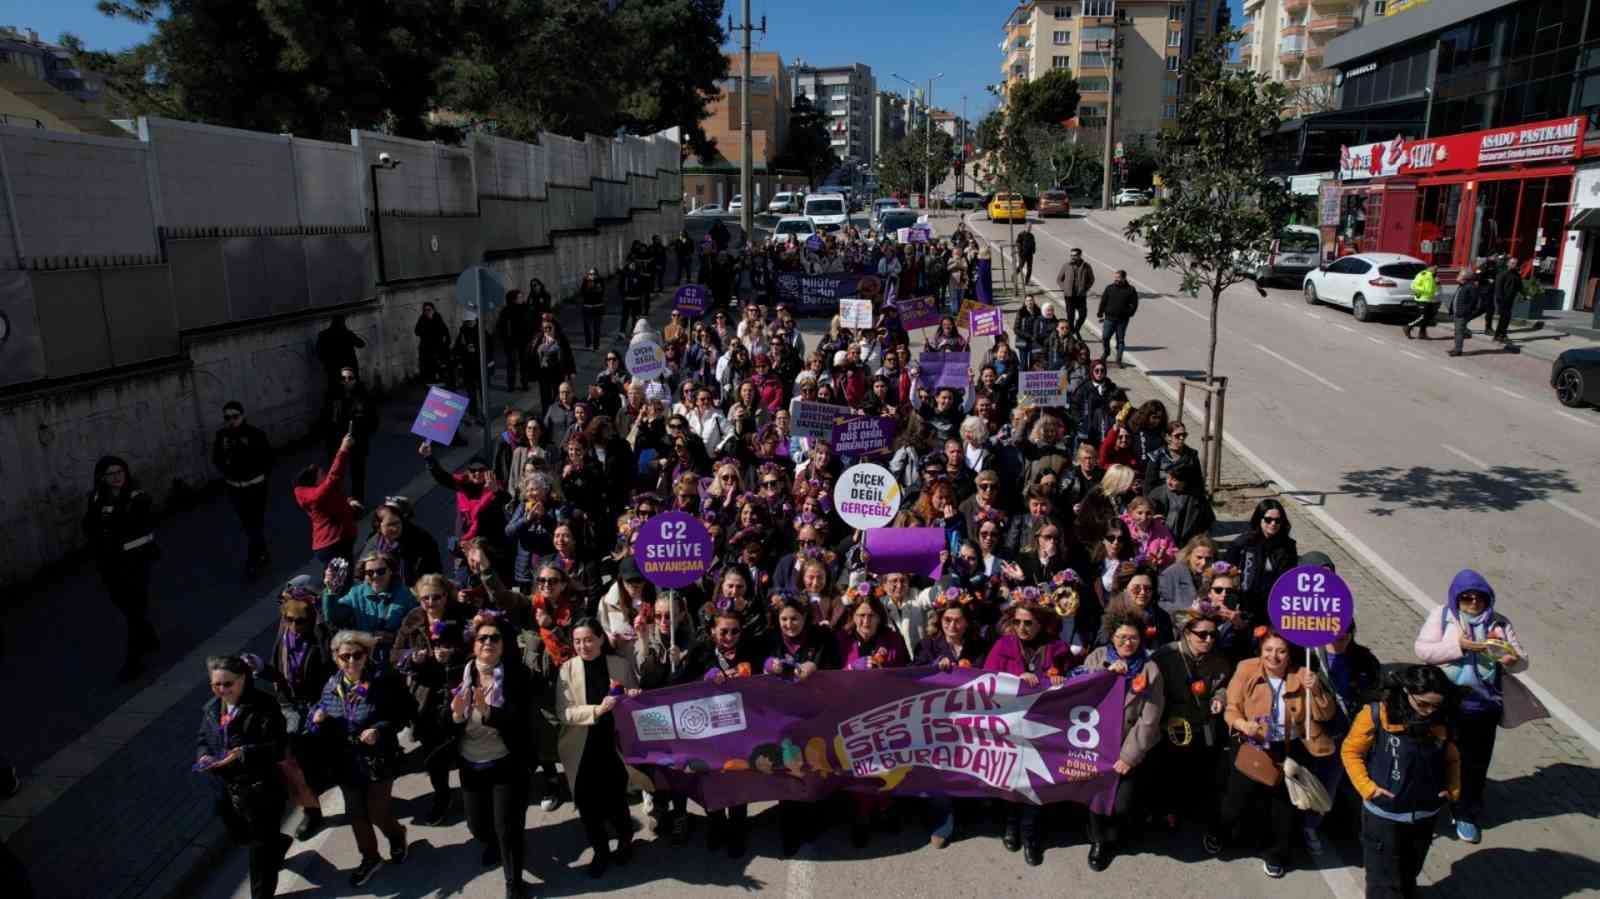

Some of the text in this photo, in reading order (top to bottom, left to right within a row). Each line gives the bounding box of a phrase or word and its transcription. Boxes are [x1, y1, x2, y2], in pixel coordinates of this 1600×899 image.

[853, 471, 885, 488] ÇİÇEK
[850, 487, 884, 502] DEĞİL
[841, 502, 892, 517] GERÇEĞİZ
[660, 520, 687, 540] C2
[646, 540, 702, 559] SEVİYE
[644, 560, 704, 574] DAYANIŞMA
[1297, 572, 1326, 593] C2
[1281, 594, 1341, 612] SEVİYE
[1280, 612, 1342, 636] DİRENİŞ
[1066, 705, 1101, 750] 8
[845, 723, 913, 759] SES
[879, 745, 1019, 789] BURADAYIZ
